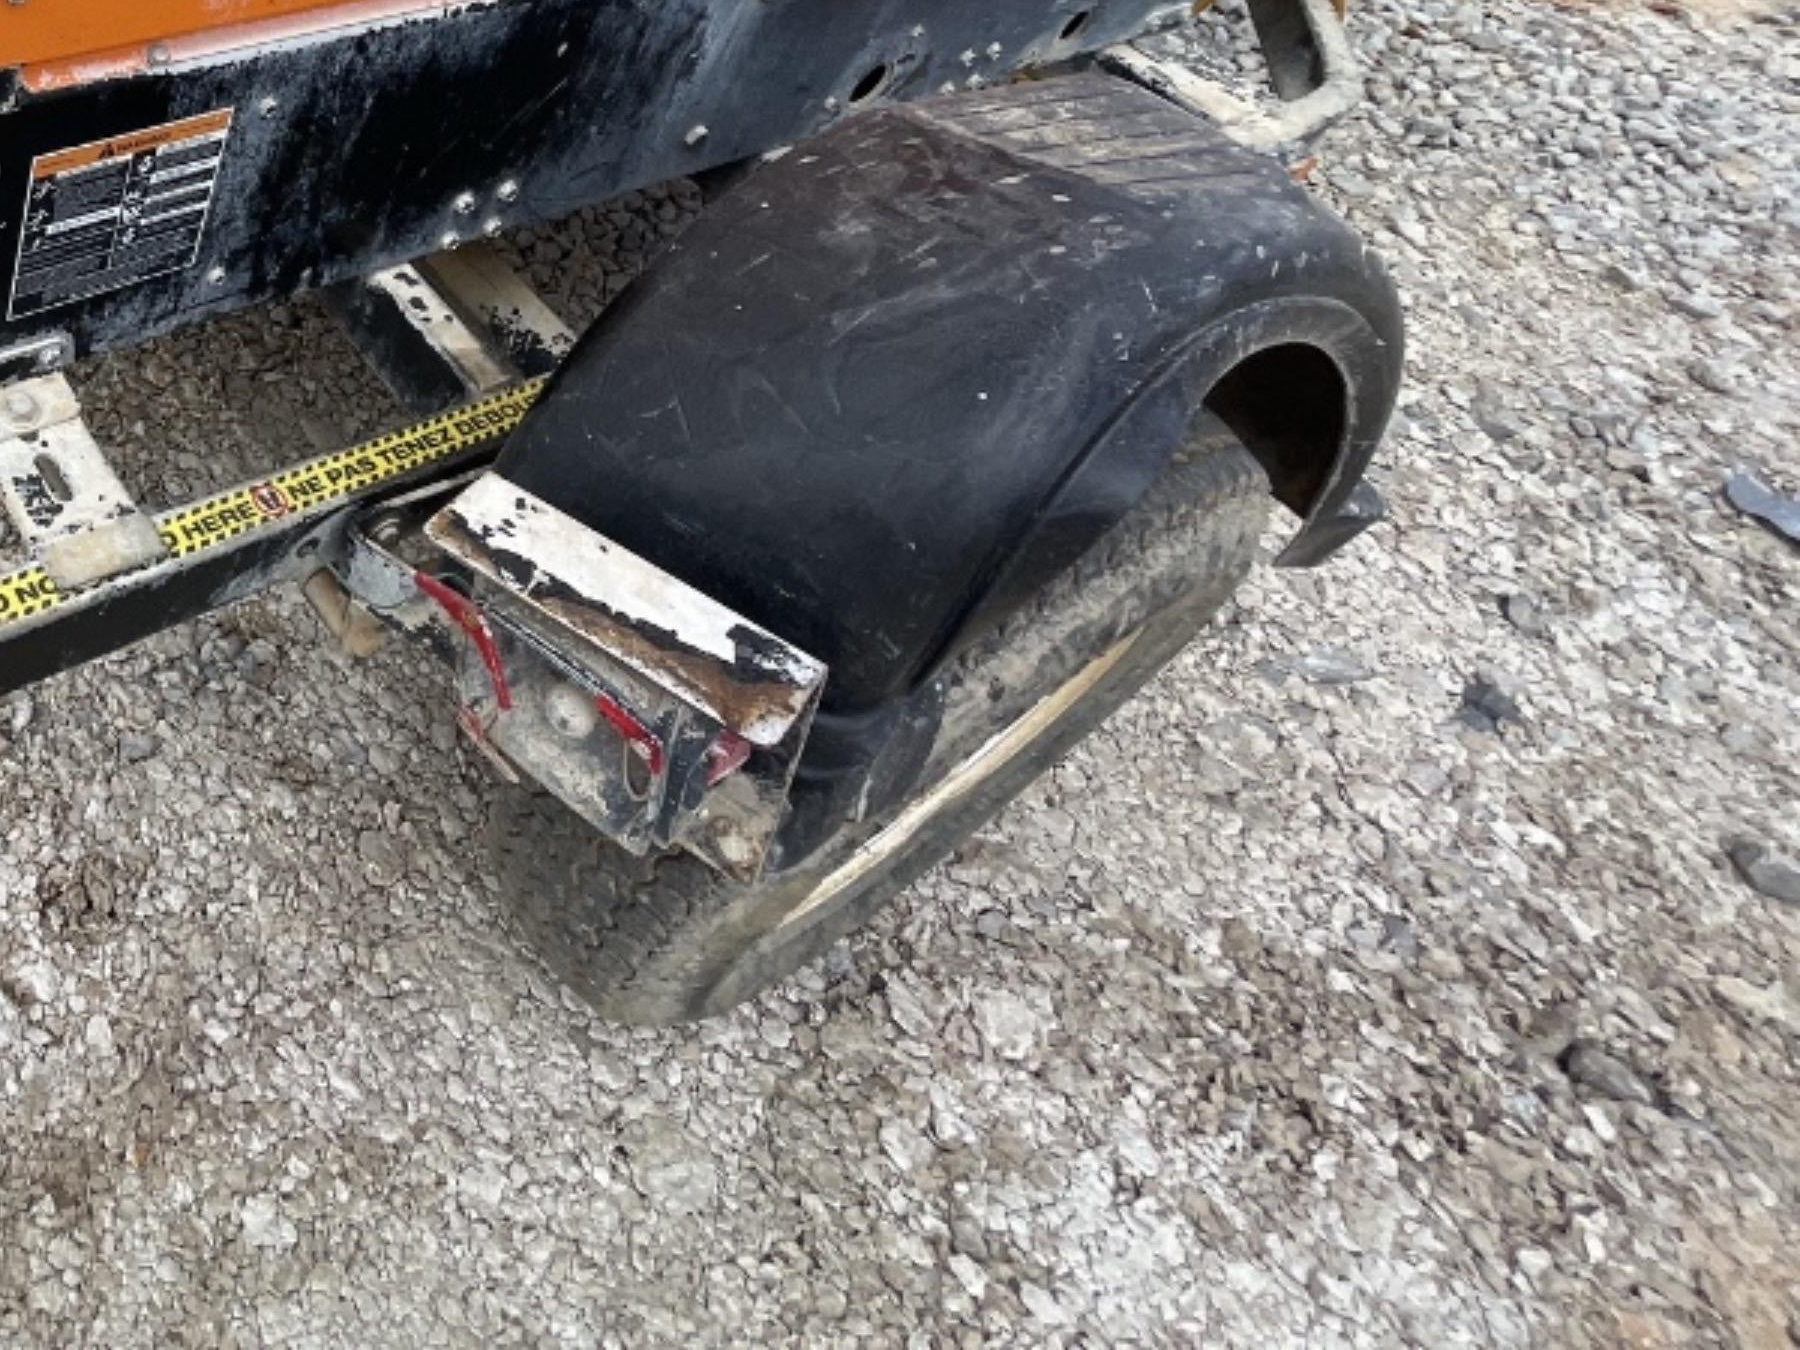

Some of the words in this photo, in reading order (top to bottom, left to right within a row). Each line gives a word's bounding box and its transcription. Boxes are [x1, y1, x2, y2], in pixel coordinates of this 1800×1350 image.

[288, 477, 322, 500] NE
[329, 459, 377, 486] PAS
[375, 431, 451, 466] TENEZ
[181, 502, 258, 541] HERE
